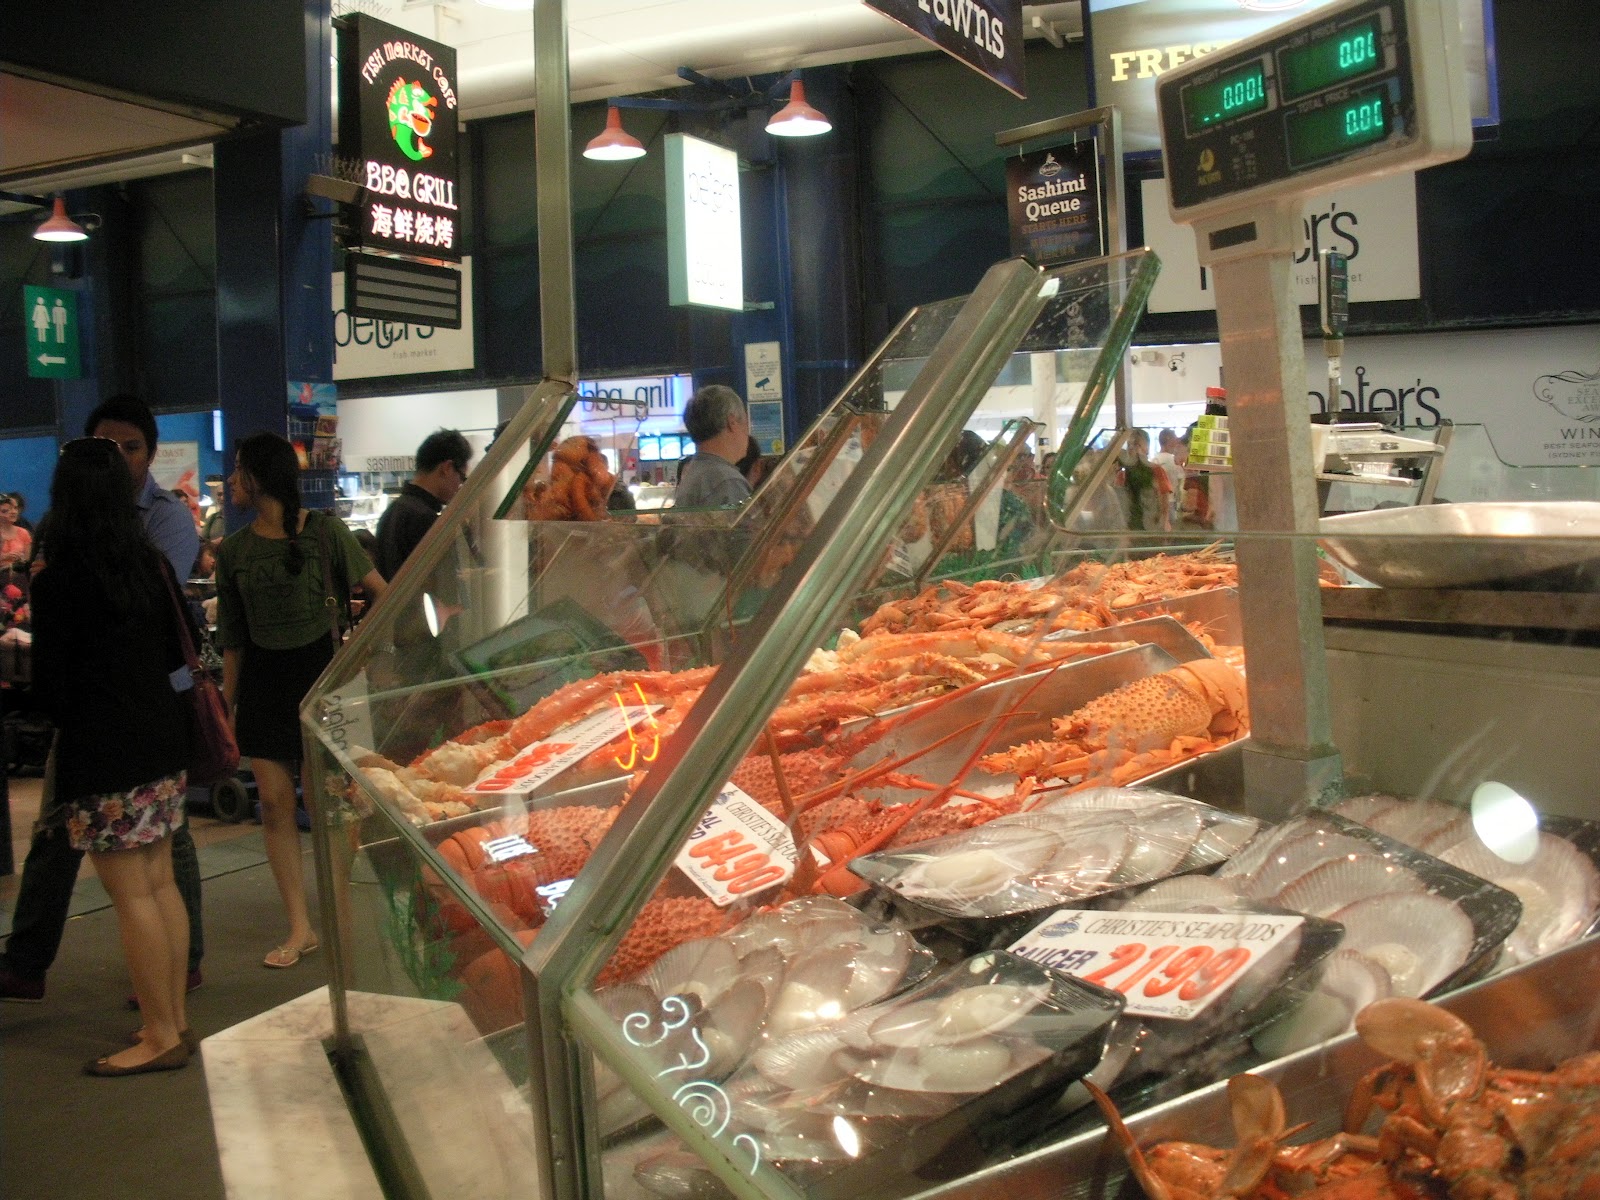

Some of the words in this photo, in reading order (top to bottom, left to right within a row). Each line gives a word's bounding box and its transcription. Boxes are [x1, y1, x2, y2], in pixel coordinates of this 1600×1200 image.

[361, 48, 386, 85] FISH
[383, 41, 434, 72] MARKET
[366, 161, 411, 199] BBQ
[413, 172, 458, 211] GRILL
[1018, 173, 1087, 203] Sashimi
[1022, 220, 1058, 235] STARTS
[1059, 213, 1087, 227] HERE
[1025, 197, 1081, 222] Queue
[371, 203, 454, 249] 海鲜烧烤
[1296, 275, 1317, 286] fish
[581, 381, 622, 416] bbq
[635, 377, 675, 422] grill
[1560, 427, 1600, 440] WIN
[366, 456, 405, 472] sashimi
[726, 800, 769, 838] CHRISTIE'S
[688, 830, 786, 895] 6490
[1083, 918, 1177, 938] CHRISTIE'S
[1175, 921, 1285, 942] SEAFOODS
[1014, 945, 1099, 971] SAUCER
[1082, 942, 1252, 1001] 2199
